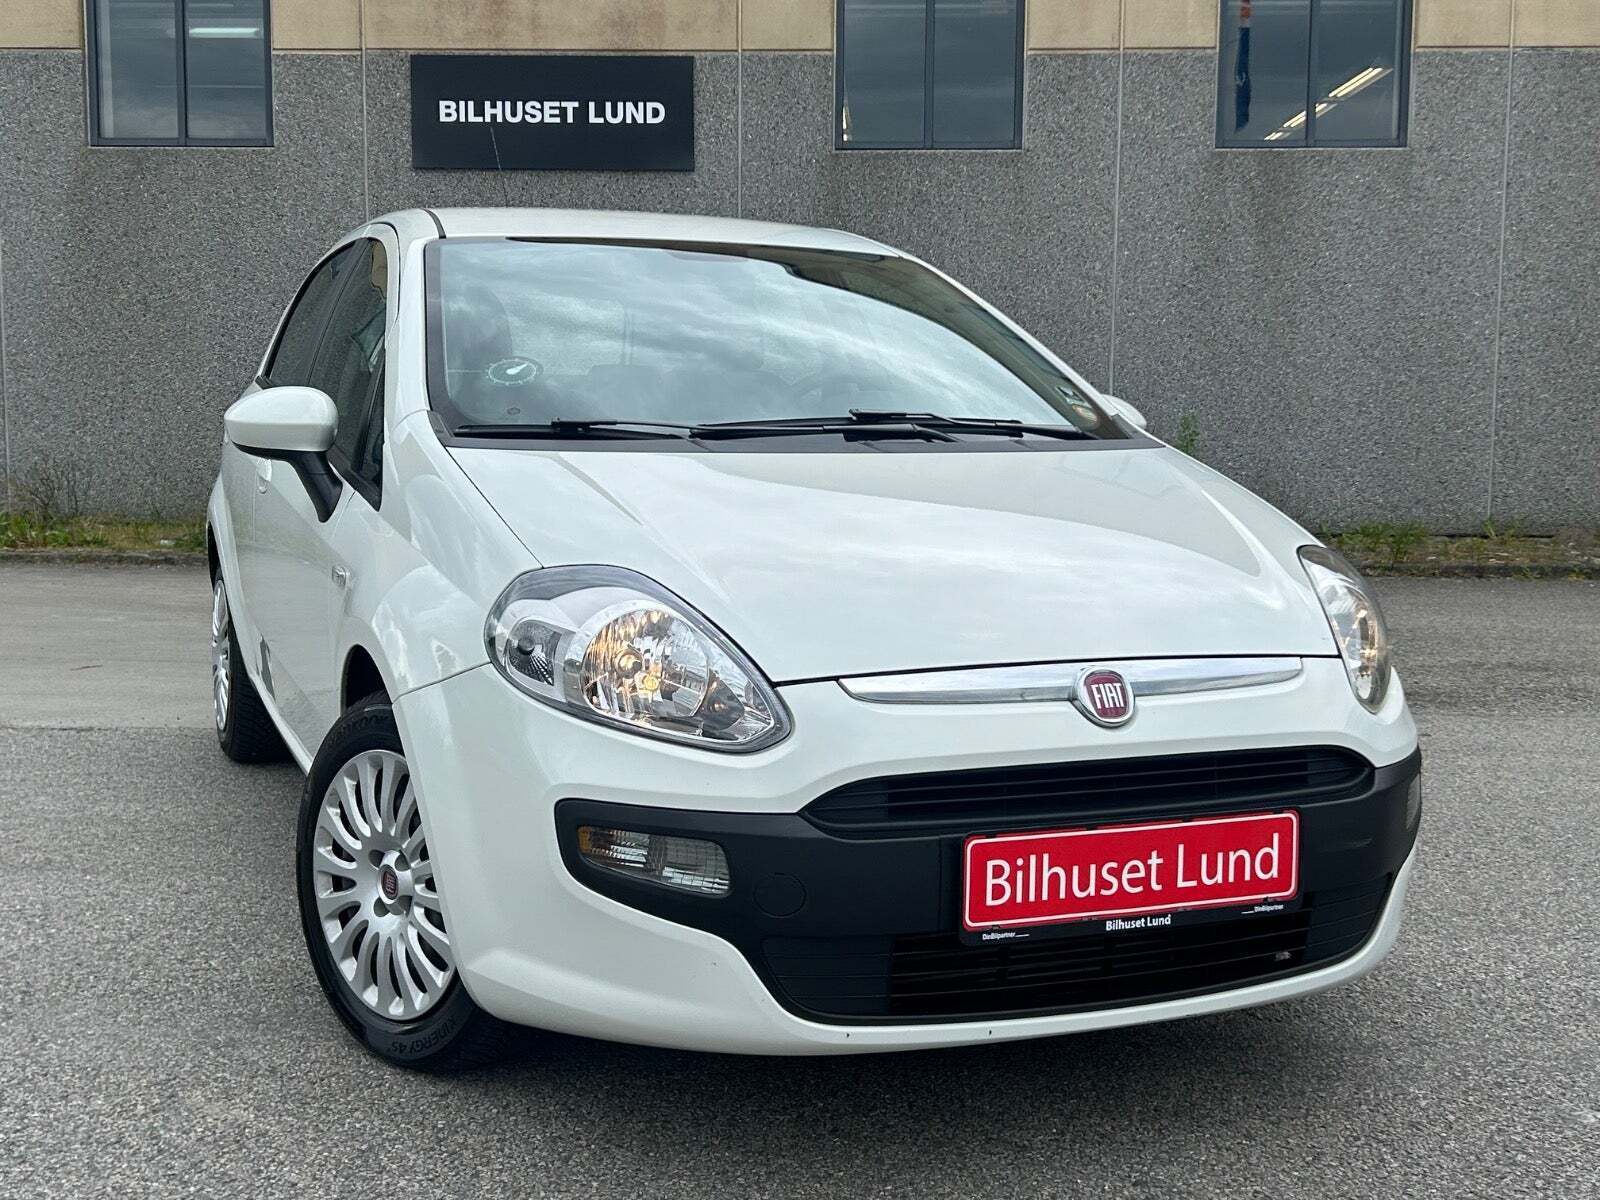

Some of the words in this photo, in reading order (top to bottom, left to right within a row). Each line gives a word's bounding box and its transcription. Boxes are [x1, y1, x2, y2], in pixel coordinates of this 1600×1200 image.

[438, 100, 579, 123] BILHUSET
[588, 101, 666, 124] LUND
[1090, 682, 1125, 709] FIAT
[986, 850, 1164, 906] Bilhuset
[1177, 833, 1279, 888] Lund
[1105, 917, 1146, 931] Bilhuset
[1147, 914, 1172, 927] Lund
